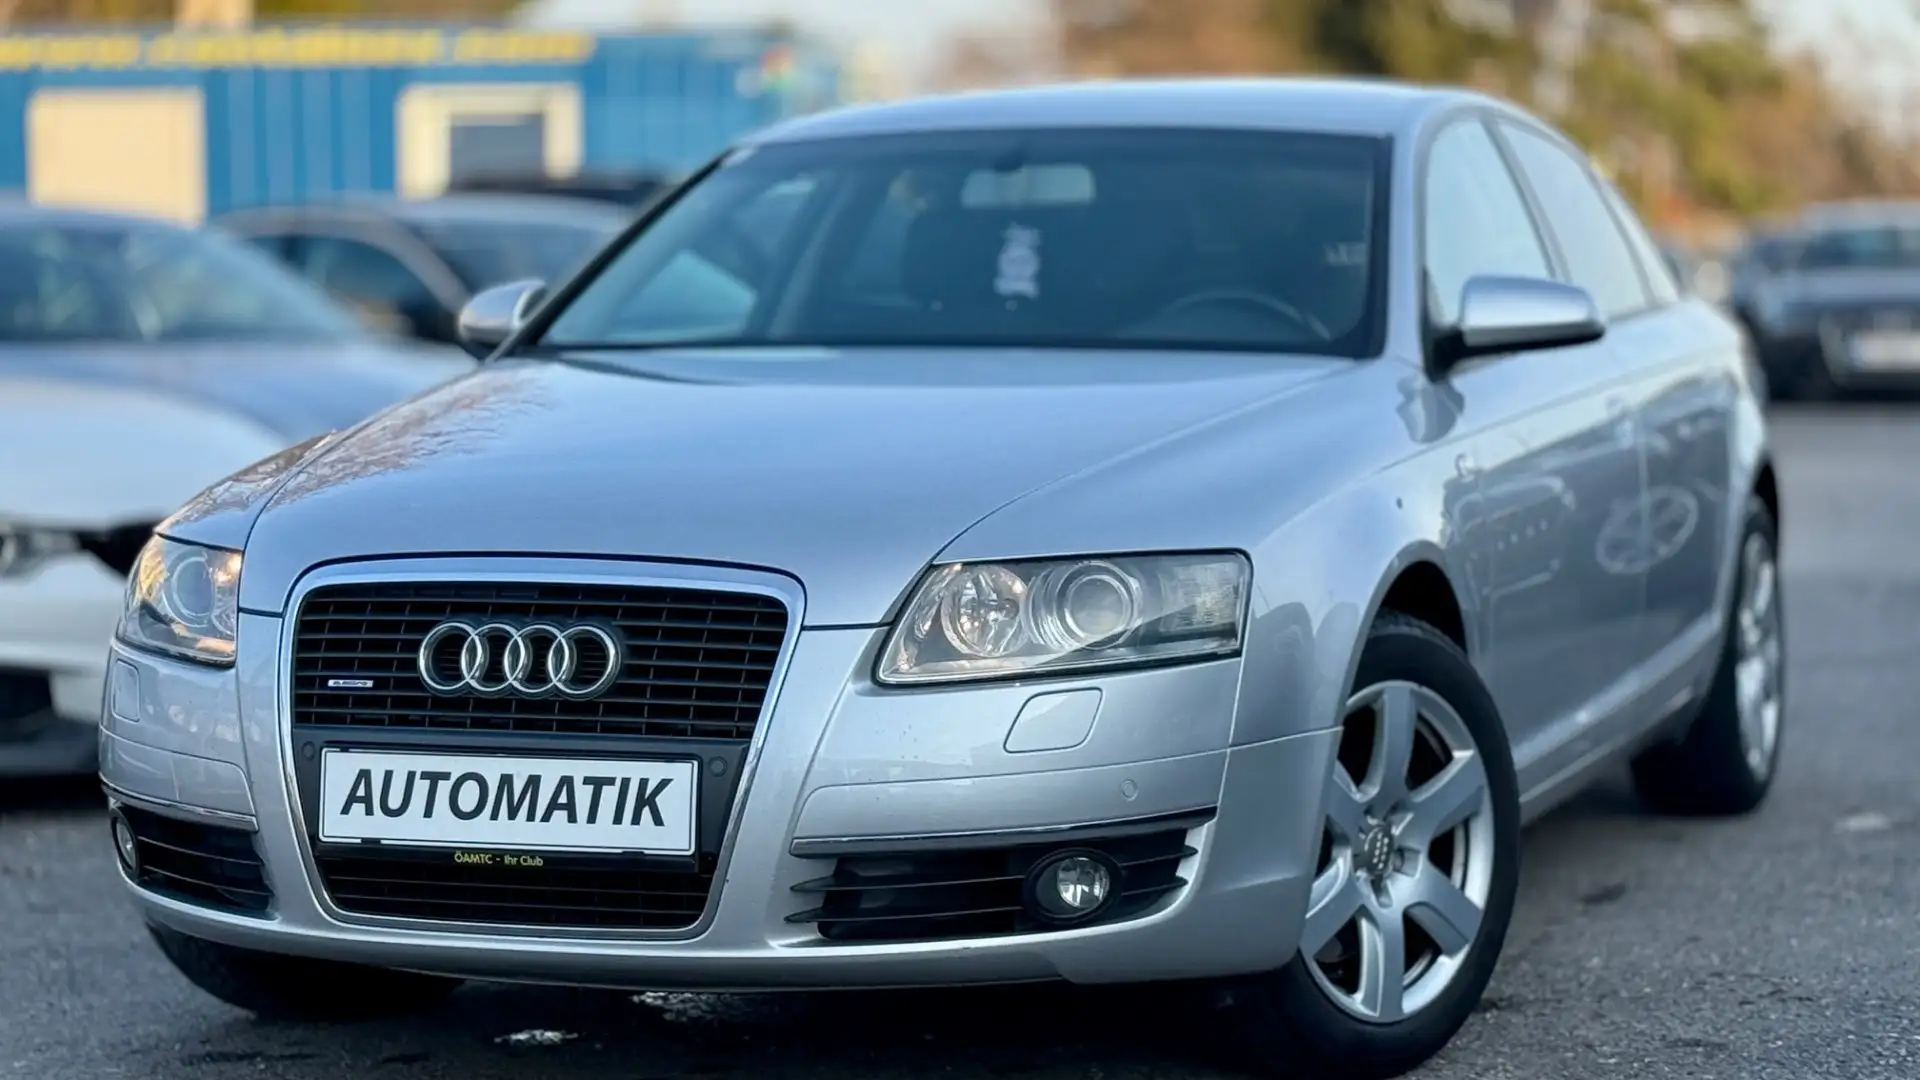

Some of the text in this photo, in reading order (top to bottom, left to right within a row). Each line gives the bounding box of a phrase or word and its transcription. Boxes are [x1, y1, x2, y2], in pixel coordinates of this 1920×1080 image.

[340, 769, 674, 827] AUTOMATIK
[454, 850, 493, 864] ÖAMTC
[504, 854, 518, 865] Ihr
[520, 855, 544, 866] Club
